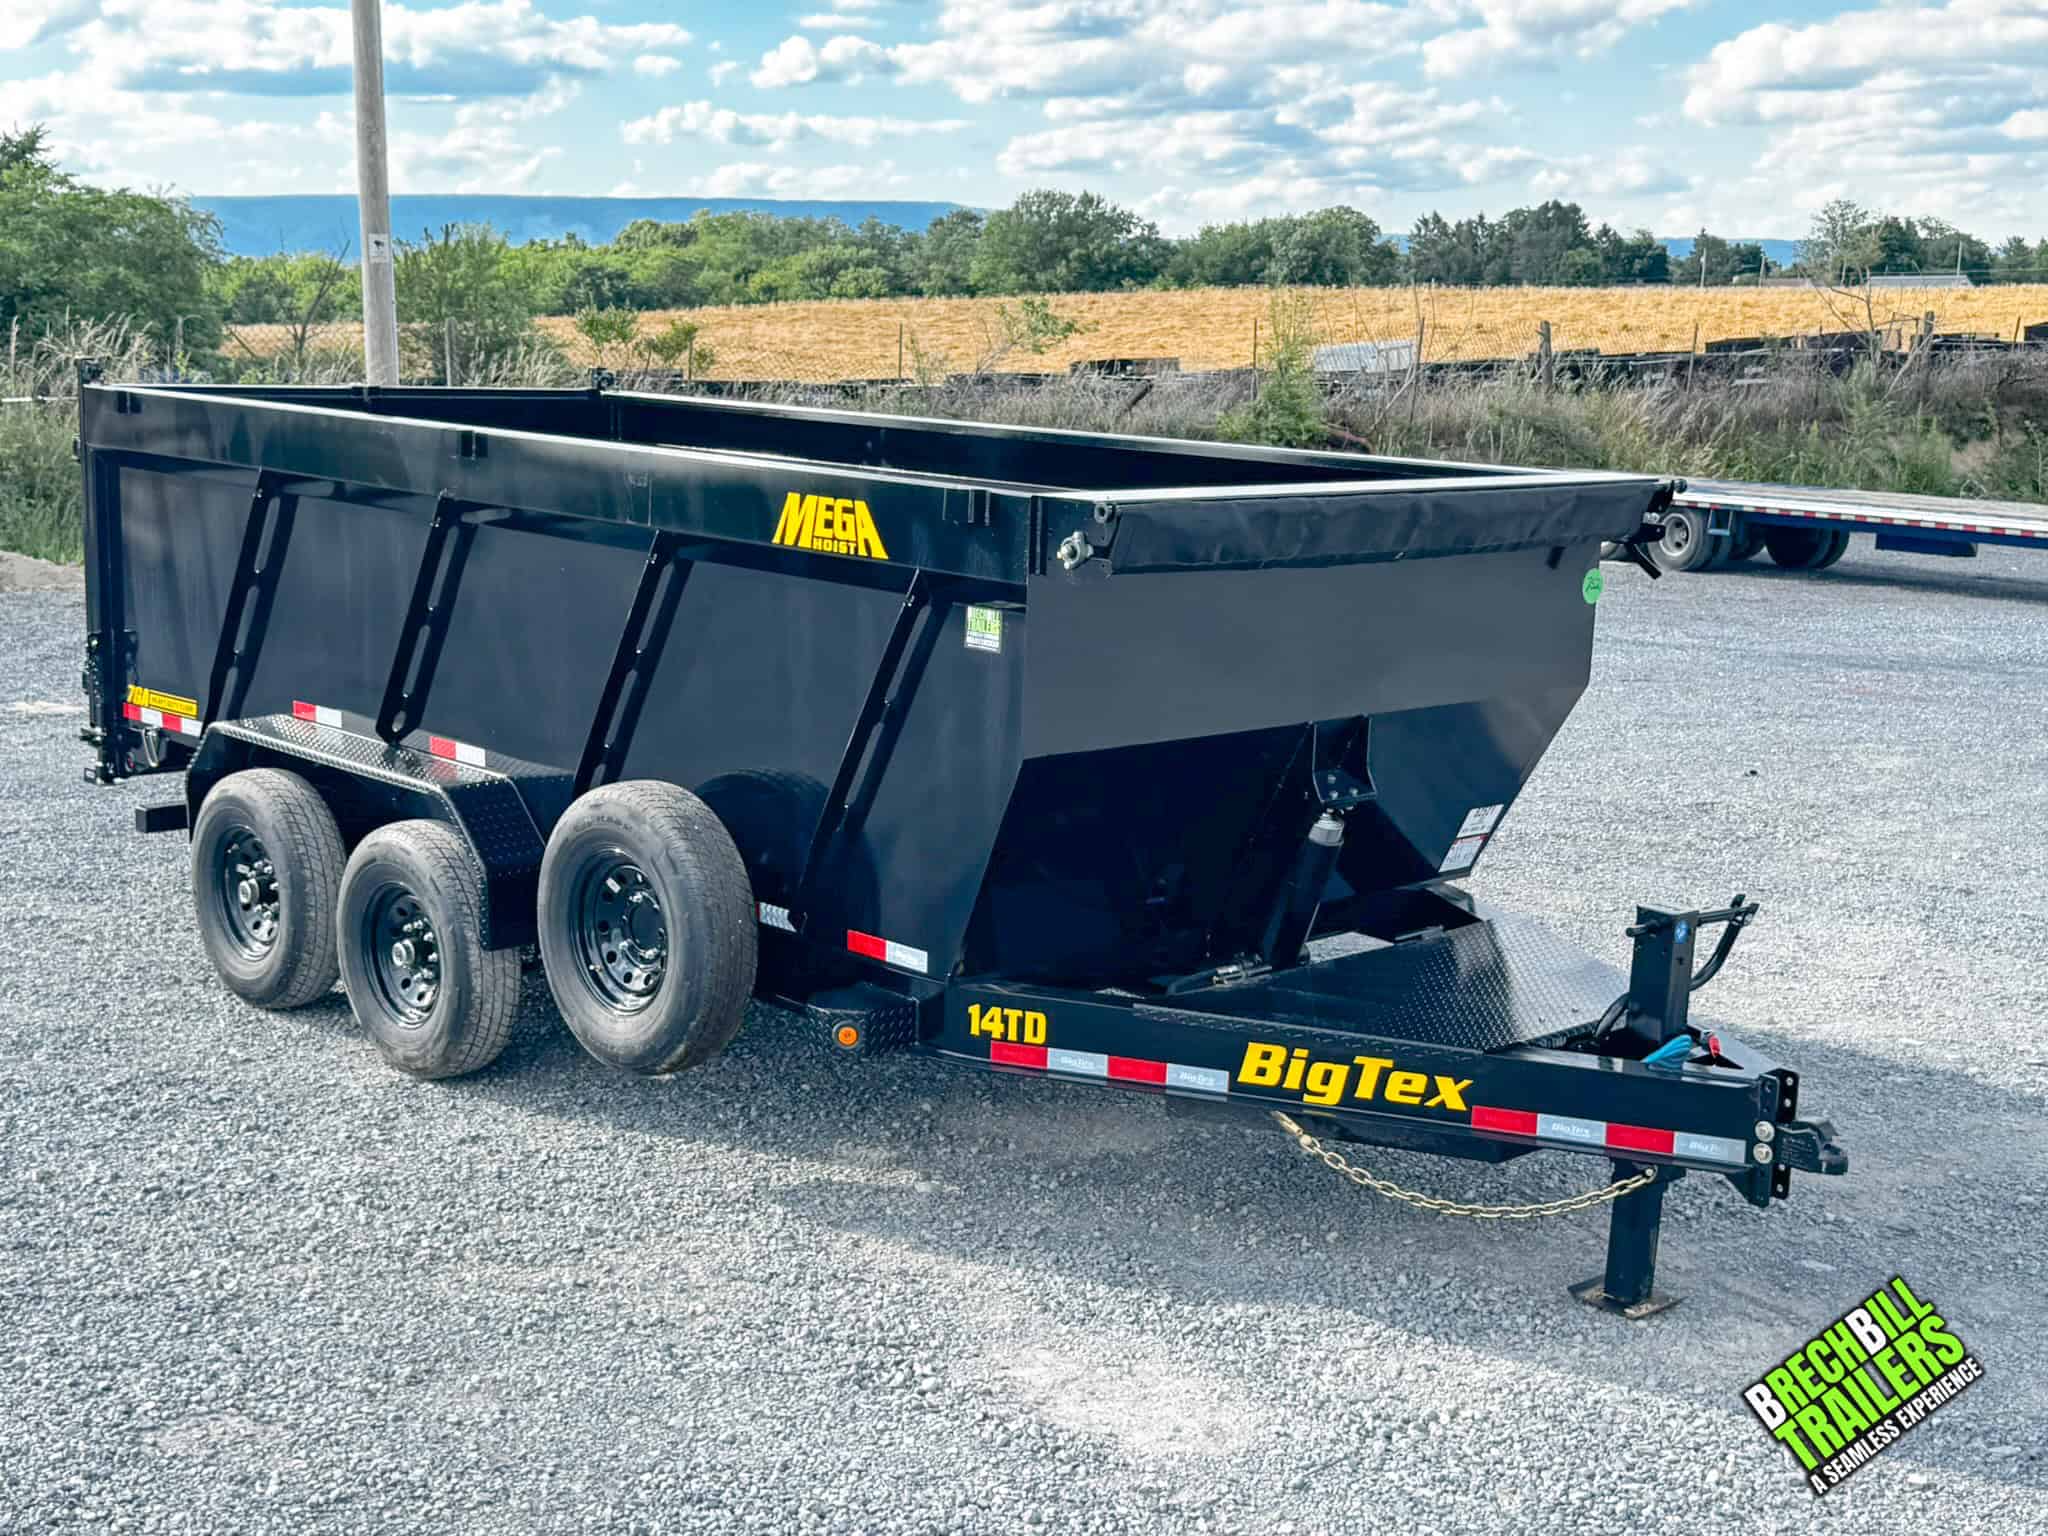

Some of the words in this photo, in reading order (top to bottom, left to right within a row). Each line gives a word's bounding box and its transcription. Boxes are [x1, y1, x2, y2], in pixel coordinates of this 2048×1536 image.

[771, 491, 889, 560] MEGA
[812, 537, 857, 556] HOIST
[968, 1003, 1048, 1045] 14TD
[1237, 1041, 1473, 1112] BigTex
